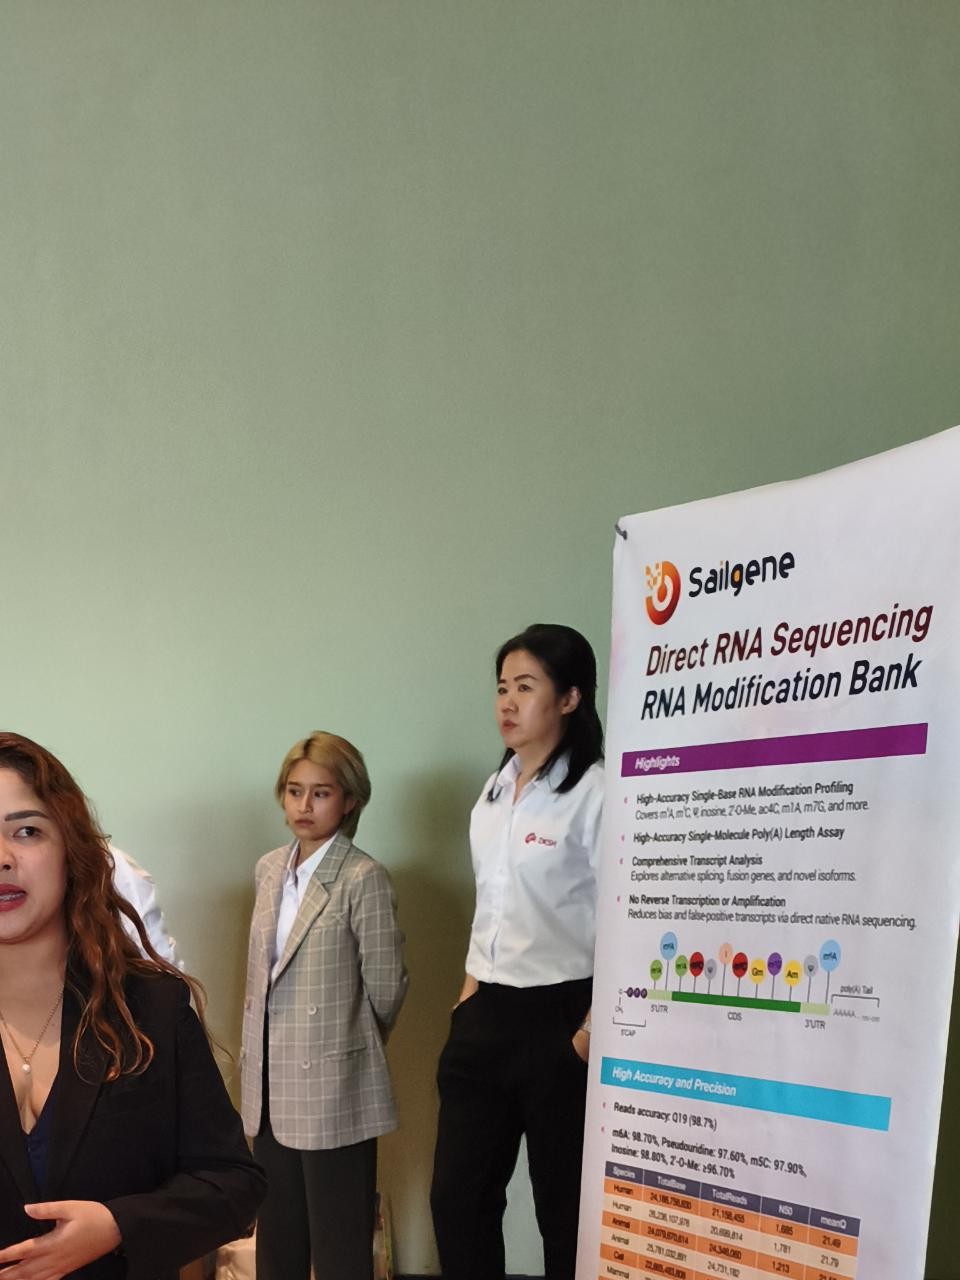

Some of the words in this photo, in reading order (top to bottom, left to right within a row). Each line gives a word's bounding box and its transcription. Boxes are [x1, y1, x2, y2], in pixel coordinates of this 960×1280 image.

[688, 551, 795, 598] Sailgene
[646, 638, 708, 676] Direct
[713, 627, 762, 666] RNA
[770, 603, 933, 657] Sequencing
[641, 686, 686, 720] RNA
[692, 668, 840, 714] Modification
[849, 653, 922, 696] Bank
[635, 755, 680, 771] Highlights
[637, 793, 690, 806] High-Accuracy
[692, 789, 736, 803] Single-Base
[739, 786, 756, 798] RNA
[758, 782, 812, 797] Modification
[815, 781, 854, 795] Profiling
[828, 800, 845, 812] and
[633, 832, 687, 845] High-Accuracy
[688, 829, 750, 844] Single-Molecule
[752, 827, 783, 842] Poly(A)
[785, 826, 815, 841] Length
[817, 827, 845, 840] Assay
[632, 855, 688, 868] Comprehensive
[690, 855, 728, 868] Transcript
[729, 853, 763, 867] Analysis
[630, 871, 659, 882] Explores
[727, 870, 750, 881] fusion
[778, 870, 793, 881] and
[794, 869, 817, 881] novel
[818, 868, 857, 881] isoforms.
[629, 894, 640, 905] No
[641, 894, 670, 905] Reverse
[672, 894, 720, 908] Transcription
[721, 897, 730, 906] or
[731, 895, 786, 909] Amplification
[628, 909, 657, 920] Reduces
[658, 909, 672, 920] bias
[674, 910, 687, 920] and
[735, 911, 776, 925] transcripts
[778, 911, 790, 924] via
[790, 912, 814, 924] direct
[815, 912, 840, 925] native
[841, 913, 861, 926] RNA
[862, 914, 917, 931] sequencing.
[612, 1066, 633, 1081] High
[633, 1070, 674, 1088] Accuracy
[675, 1077, 692, 1090] and
[693, 1079, 737, 1097] Precision
[614, 1102, 636, 1114] Reads
[671, 1112, 688, 1124] Q19
[689, 1114, 718, 1132] (98.7%)
[611, 1143, 640, 1159] Inosine:
[661, 1136, 716, 1157] Pseudouridine:
[717, 1148, 749, 1166] 97.60%,
